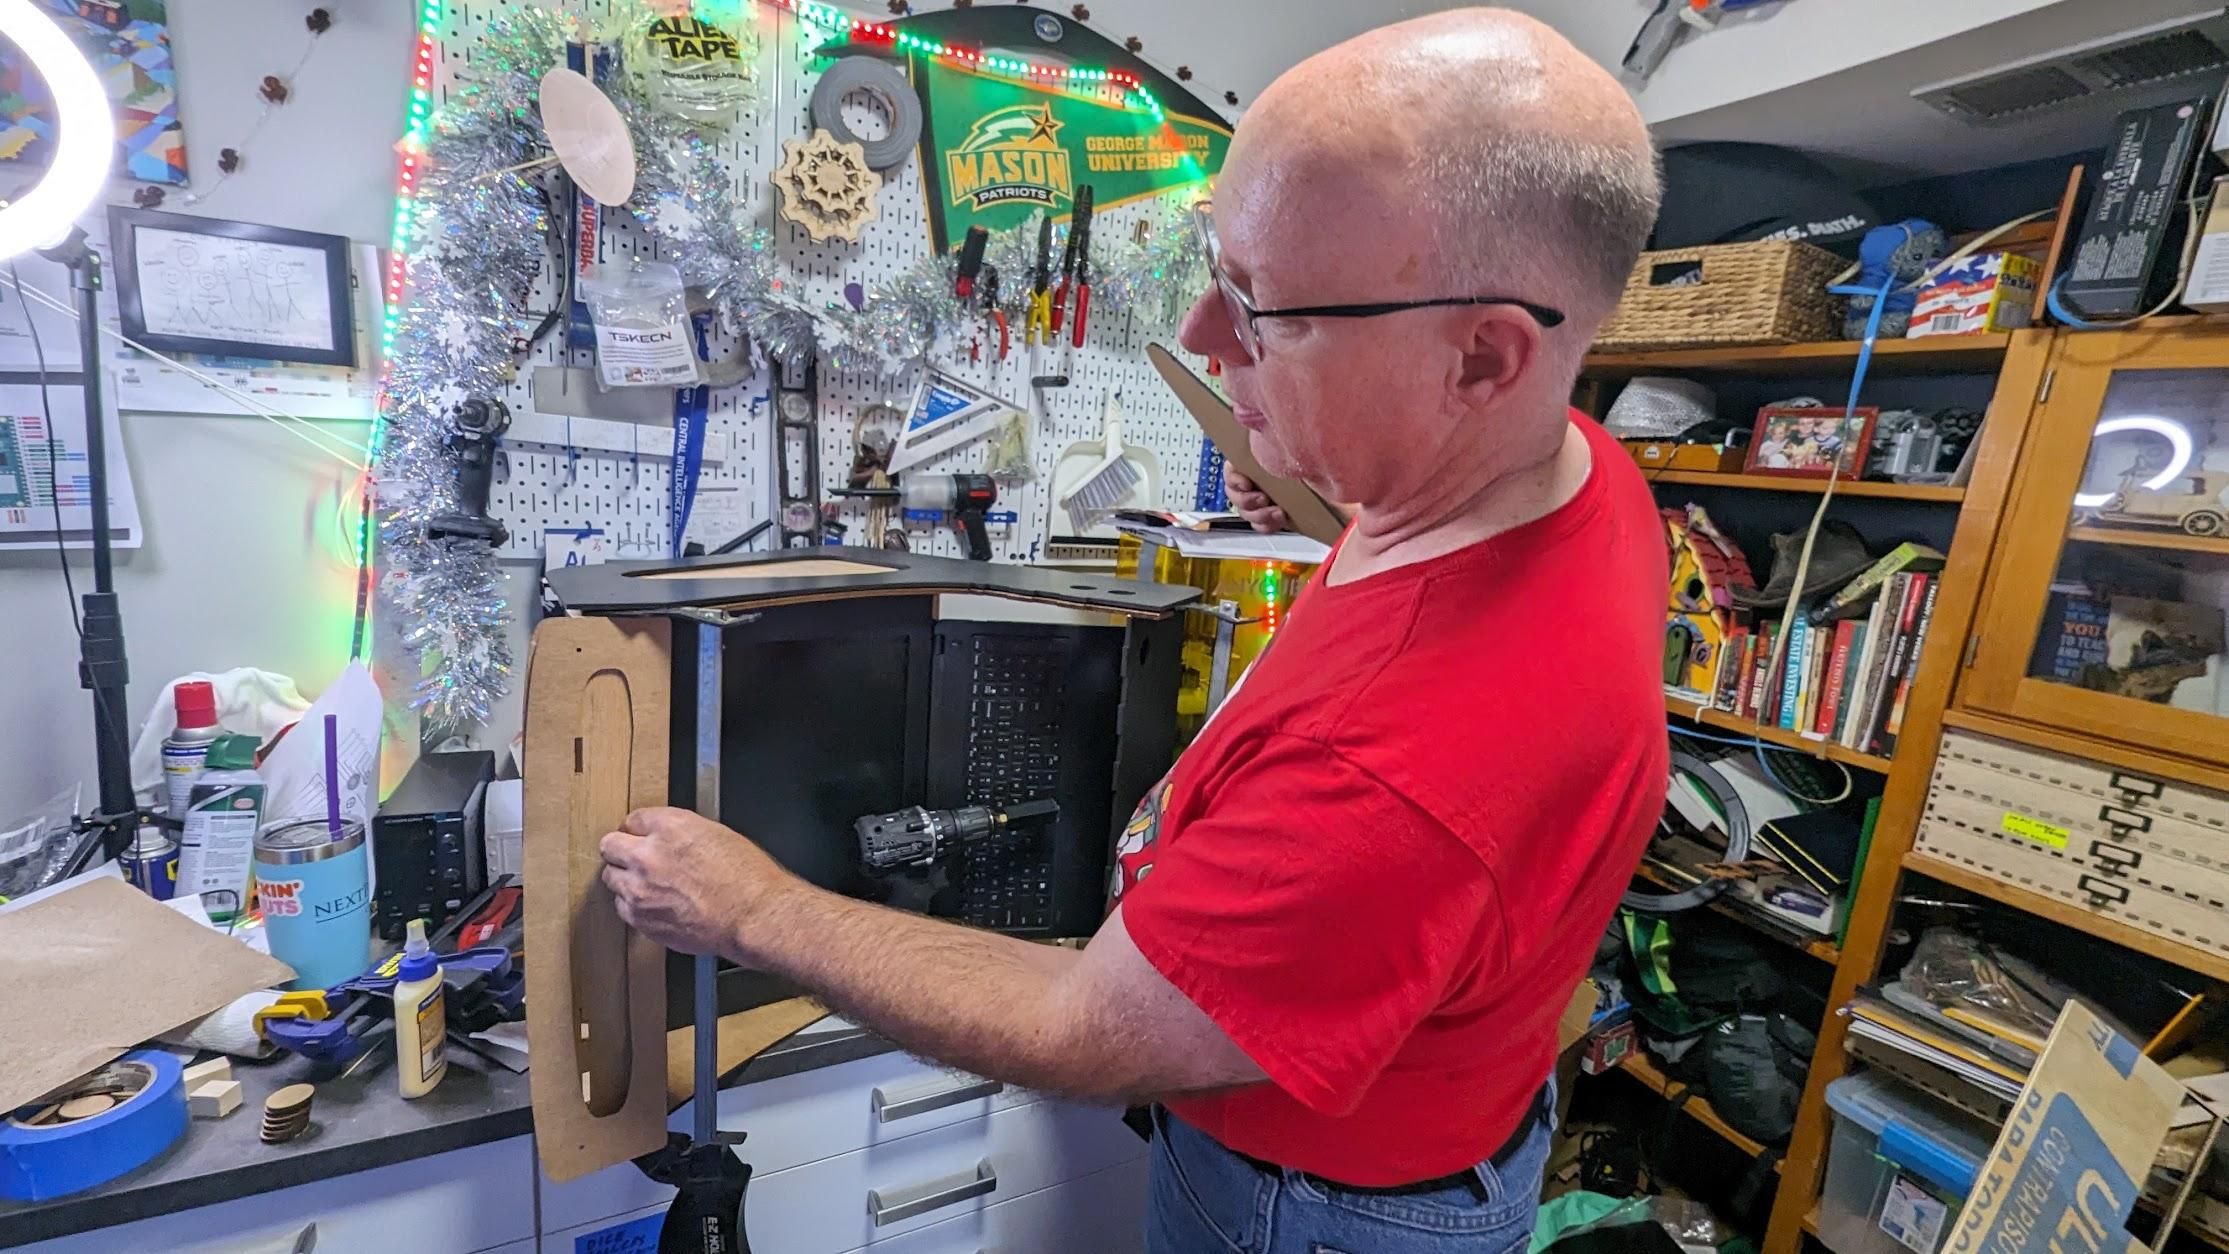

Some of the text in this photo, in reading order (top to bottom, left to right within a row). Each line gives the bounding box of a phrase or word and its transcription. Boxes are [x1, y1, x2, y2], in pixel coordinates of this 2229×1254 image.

[661, 38, 742, 61] TAPE
[1086, 134, 1210, 152] GEORGE MAON
[951, 151, 1070, 199] MASON
[1087, 152, 1210, 172] UNIVERSIY
[979, 186, 1048, 203] PATRIOTS
[608, 330, 673, 344] TSKECN
[677, 417, 689, 454] CENTRAL
[674, 454, 686, 512] INTELLIGENCE
[1788, 628, 1803, 661] ESTATE
[2078, 637, 2108, 650] TEAC
[1782, 662, 1799, 712] INVESTING
[259, 882, 300, 898] KIN'
[313, 882, 369, 917] NEXT
[1990, 1126, 2071, 1254] CONTRAPISO
[2048, 1168, 2121, 1254] UL
